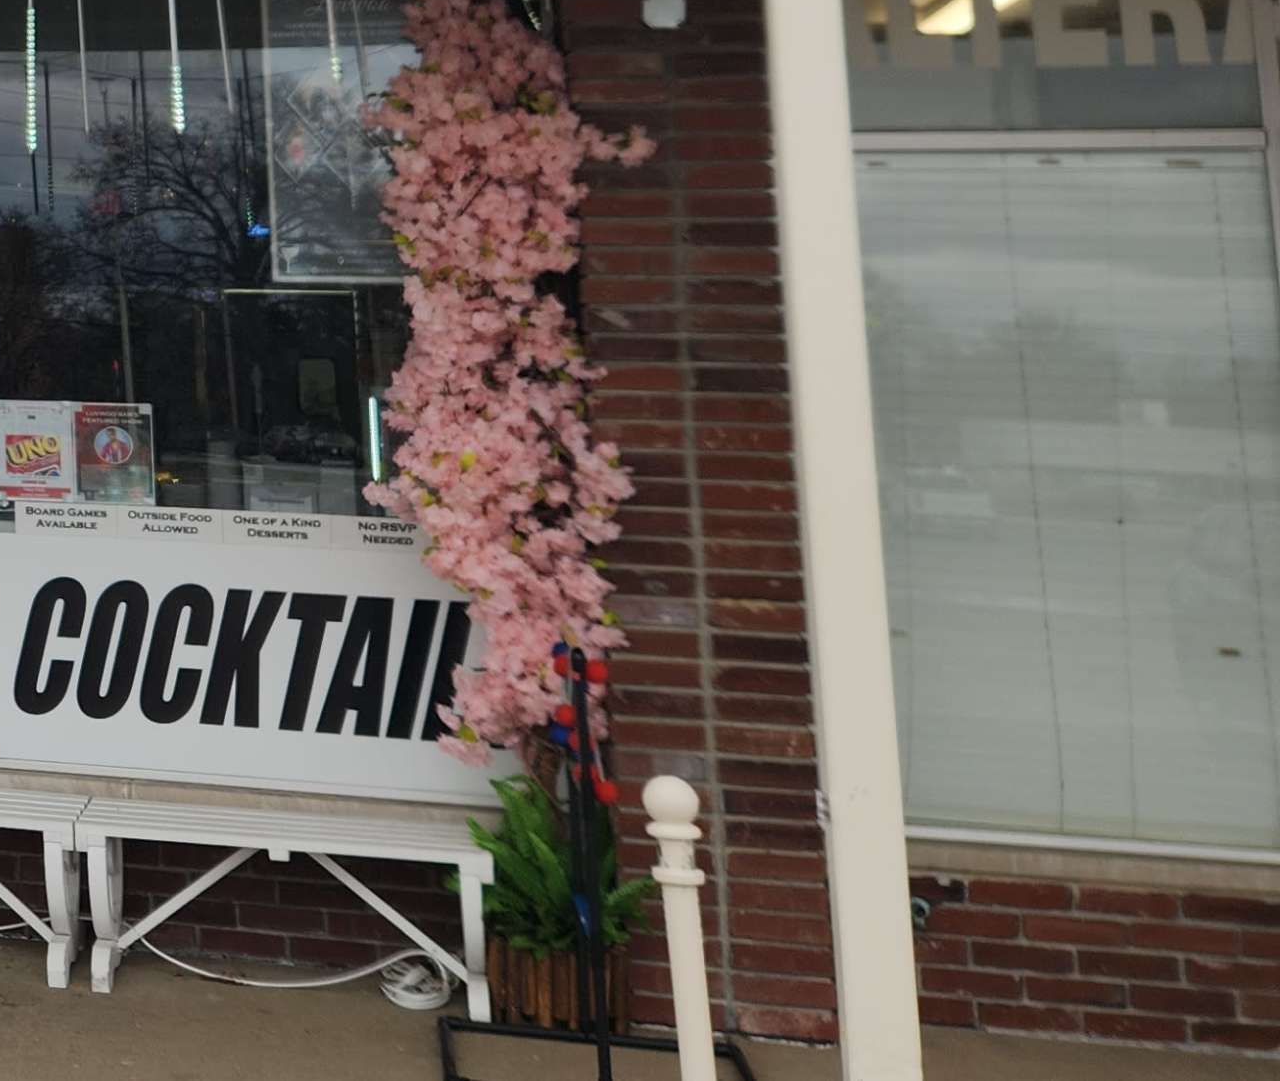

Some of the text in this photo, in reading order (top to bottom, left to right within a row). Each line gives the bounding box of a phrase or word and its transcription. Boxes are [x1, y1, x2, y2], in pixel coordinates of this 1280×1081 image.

[6, 434, 60, 465] UNO
[25, 506, 107, 518] BOARD GAMES
[128, 510, 213, 523] OUTSIDE FOOD
[36, 519, 98, 530] AVAILABLE
[233, 515, 261, 525] ONE
[291, 519, 321, 528] KIND
[358, 521, 417, 533] NO RSVP
[142, 524, 199, 535] ALLOWED
[247, 528, 309, 540] DESSERTS
[362, 534, 414, 546] NEEDED
